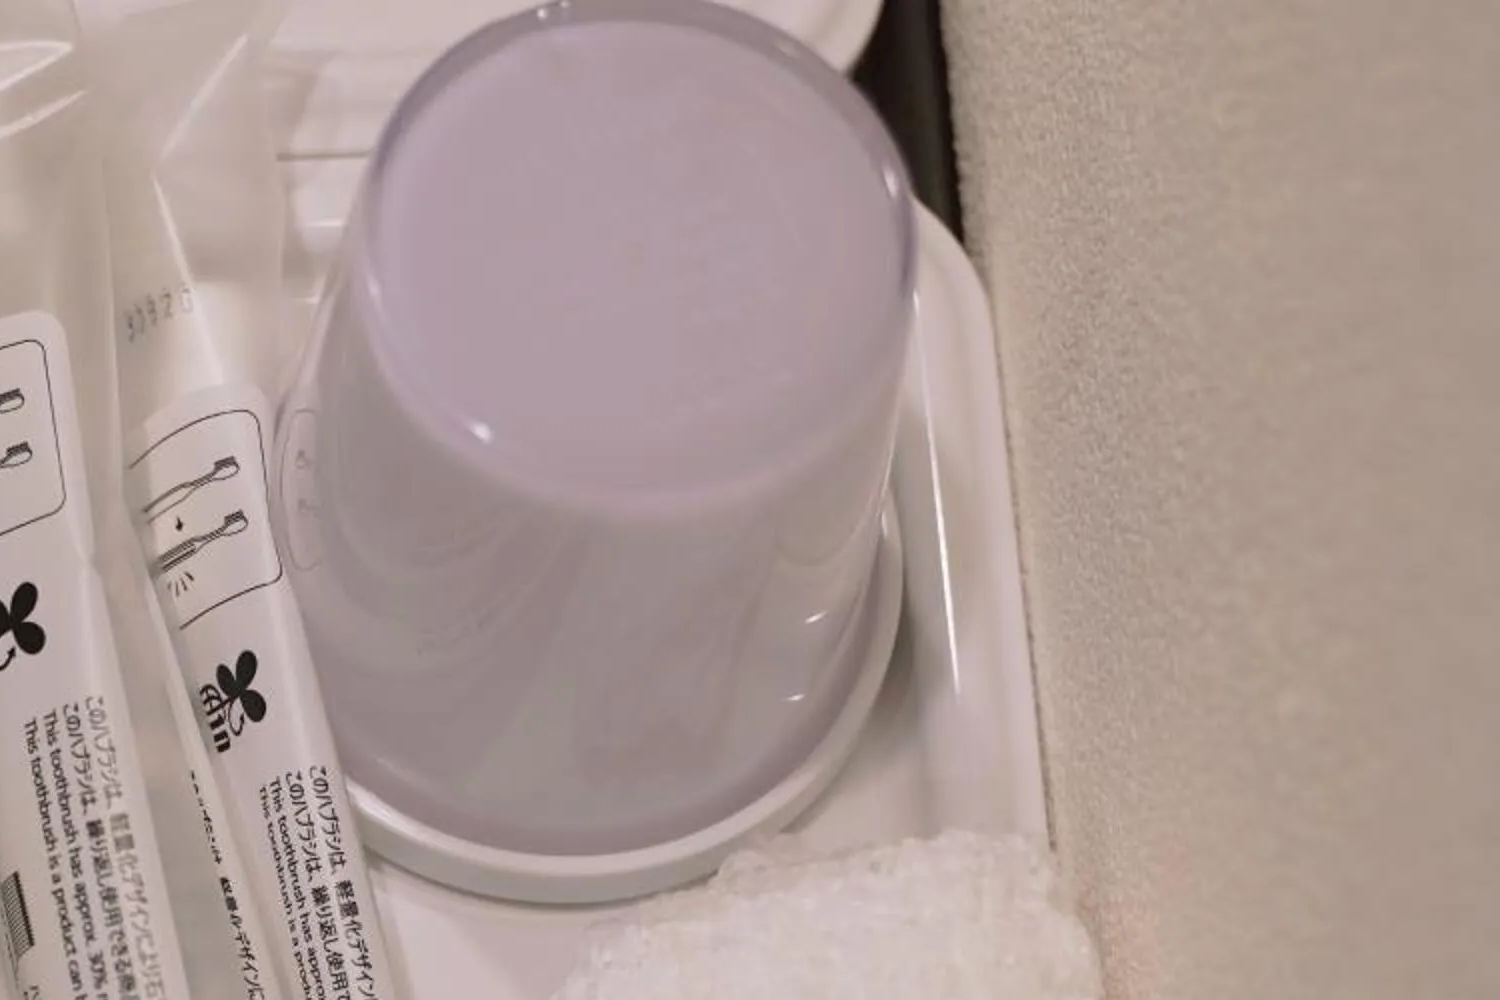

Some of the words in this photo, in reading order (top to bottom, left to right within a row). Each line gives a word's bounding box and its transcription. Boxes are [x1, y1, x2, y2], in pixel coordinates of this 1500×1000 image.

[23, 717, 39, 755] This
[42, 709, 58, 746] This
[30, 755, 57, 852] toothbrush
[49, 747, 79, 845] toothbrush
[268, 775, 285, 813] This
[47, 854, 60, 870] is
[50, 872, 62, 885] a
[67, 845, 83, 878] has
[276, 814, 306, 910] toothbrush
[50, 886, 77, 957] product
[298, 911, 313, 943] has
[67, 958, 82, 991] can
